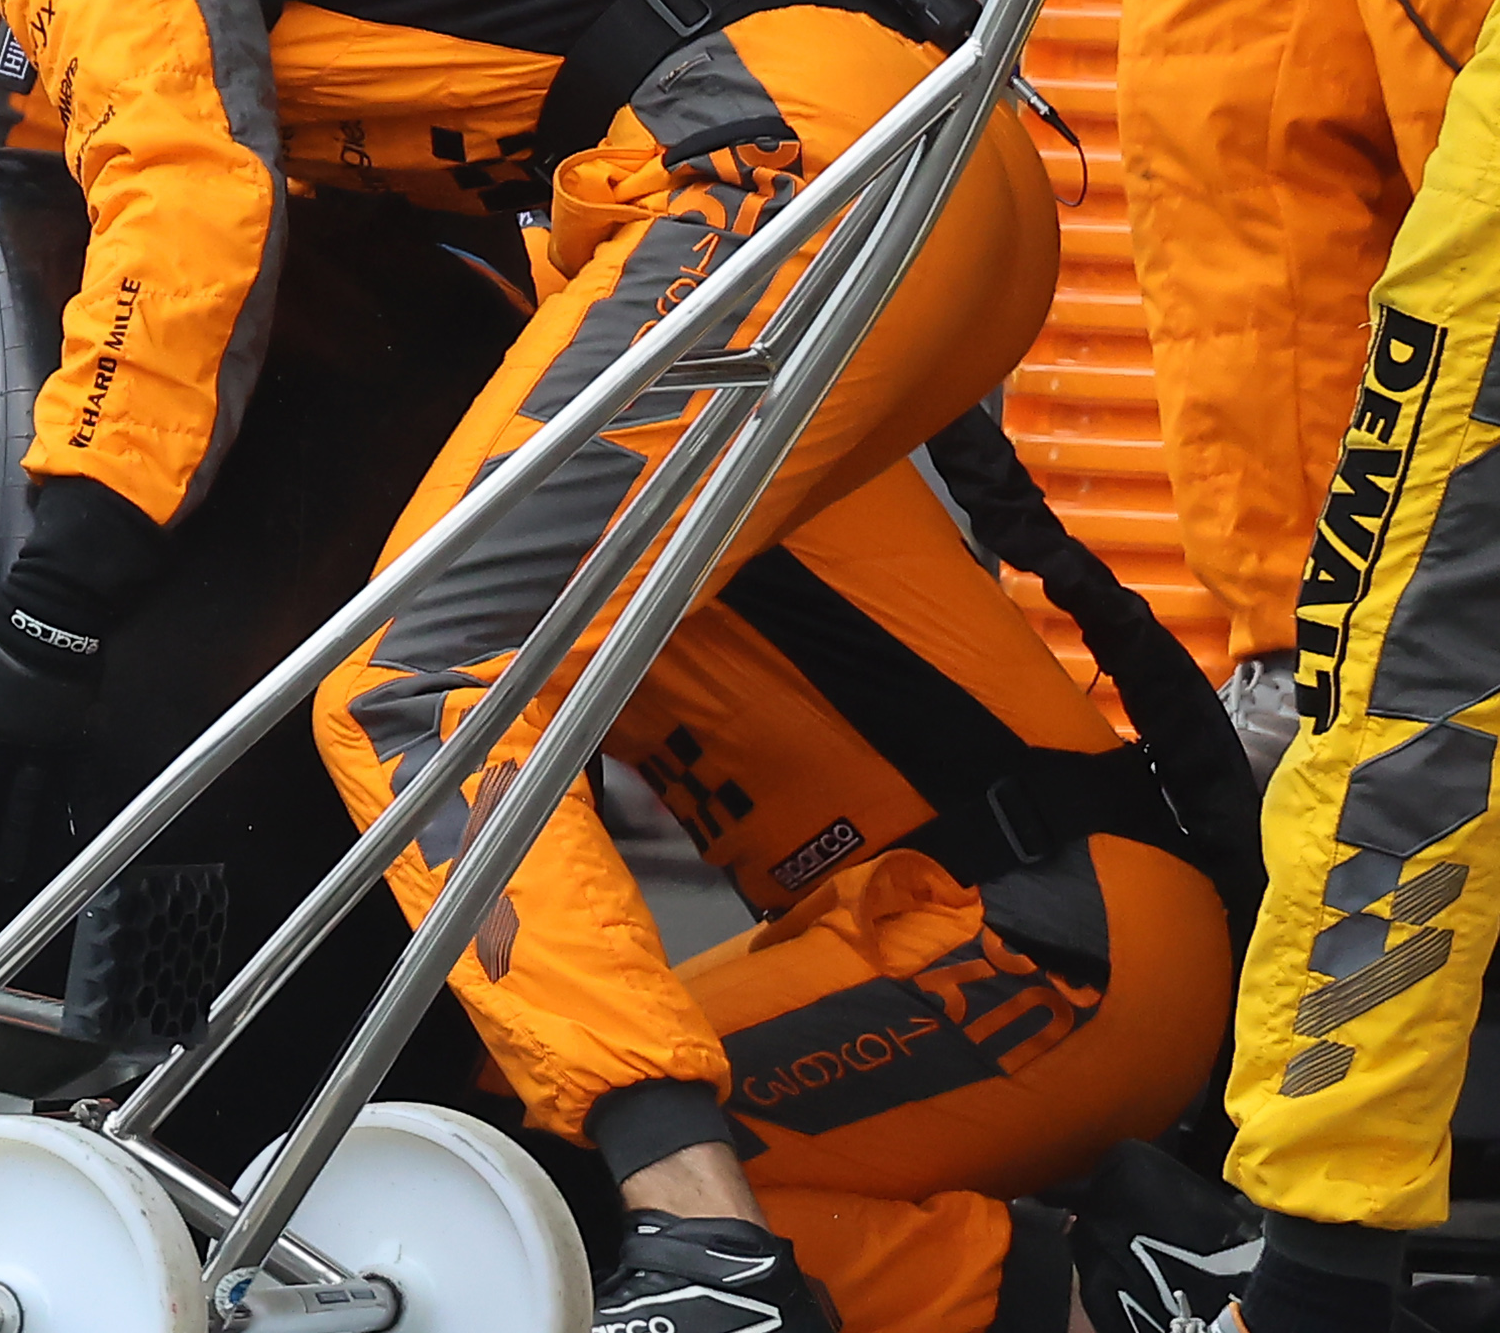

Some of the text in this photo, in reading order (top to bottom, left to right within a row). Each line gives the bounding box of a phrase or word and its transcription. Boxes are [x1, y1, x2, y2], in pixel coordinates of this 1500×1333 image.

[103, 274, 142, 354] MILLE
[10, 608, 97, 656] sparco
[774, 821, 856, 889] sparco
